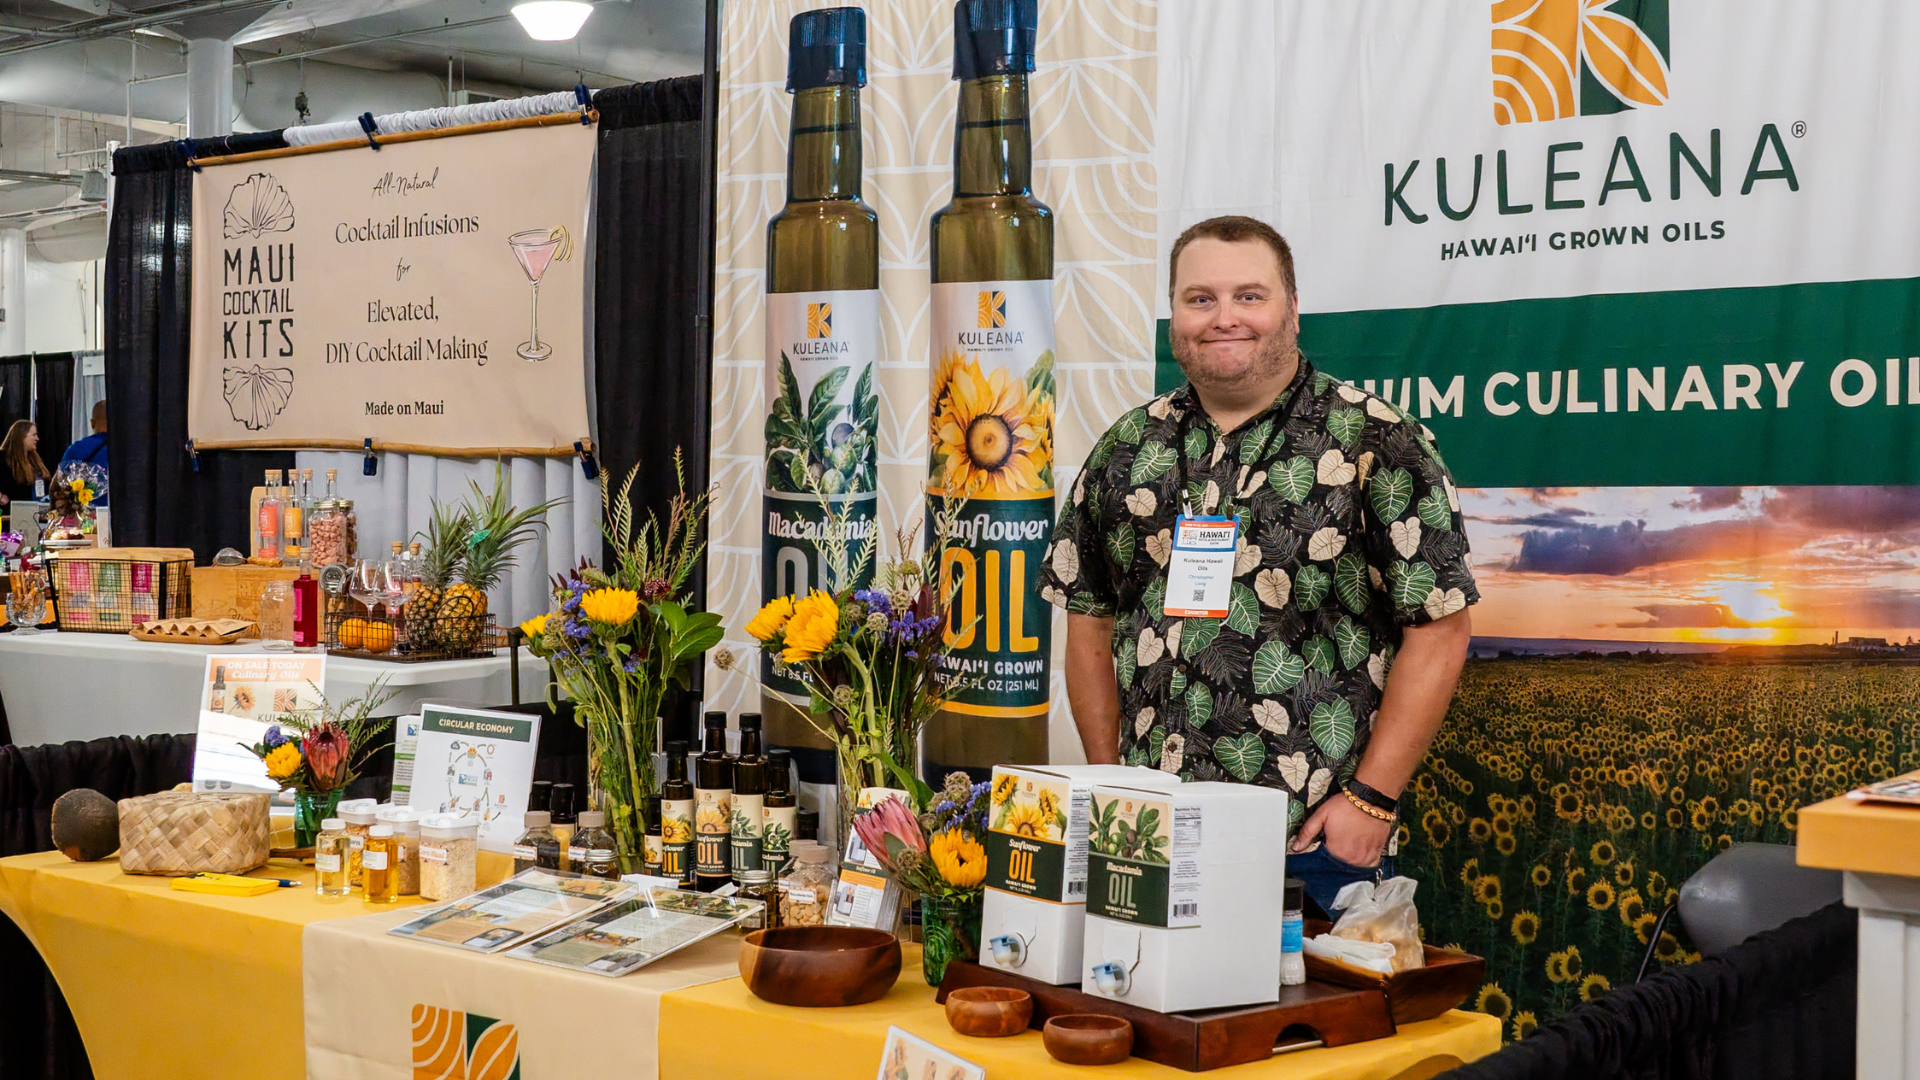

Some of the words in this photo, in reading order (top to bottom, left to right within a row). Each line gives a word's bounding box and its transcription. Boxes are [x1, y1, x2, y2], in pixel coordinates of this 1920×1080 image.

[372, 166, 439, 199] All-Natural
[335, 216, 399, 244] Cocktail
[403, 214, 480, 238] Infusions
[1549, 226, 1649, 251] GROWN
[1662, 220, 1725, 243] OILS
[223, 243, 295, 286] MAUI
[396, 257, 411, 281] for
[223, 288, 294, 316] COCKTAIL
[367, 297, 439, 324] Elevated,
[223, 318, 294, 359] KITS
[326, 341, 352, 364] DIY
[356, 338, 422, 363] Cocktail
[426, 337, 488, 366] Making
[1483, 360, 1804, 417] CULINARY
[364, 402, 393, 416] Made
[397, 405, 411, 416] on
[414, 400, 444, 415] Maui
[933, 510, 1048, 548] Sunflower
[940, 547, 1040, 653] OIL
[227, 661, 243, 669] ON
[244, 661, 270, 670] SALE
[271, 661, 306, 669] TODAY
[231, 670, 278, 680] Culinary
[280, 669, 300, 679] Oils
[994, 659, 1044, 676] GROWN
[934, 671, 952, 684] NET
[987, 679, 1003, 691] OZ
[1005, 680, 1023, 693] (251
[1024, 679, 1040, 692] ML)
[438, 718, 475, 730] CIRCULAR
[475, 722, 515, 734] ECONOMY
[697, 842, 724, 865] OIL
[1008, 838, 1041, 853] Sunflower
[1008, 849, 1036, 884] OIL
[1106, 861, 1143, 876] Macadamia
[1108, 873, 1137, 909] OIL
